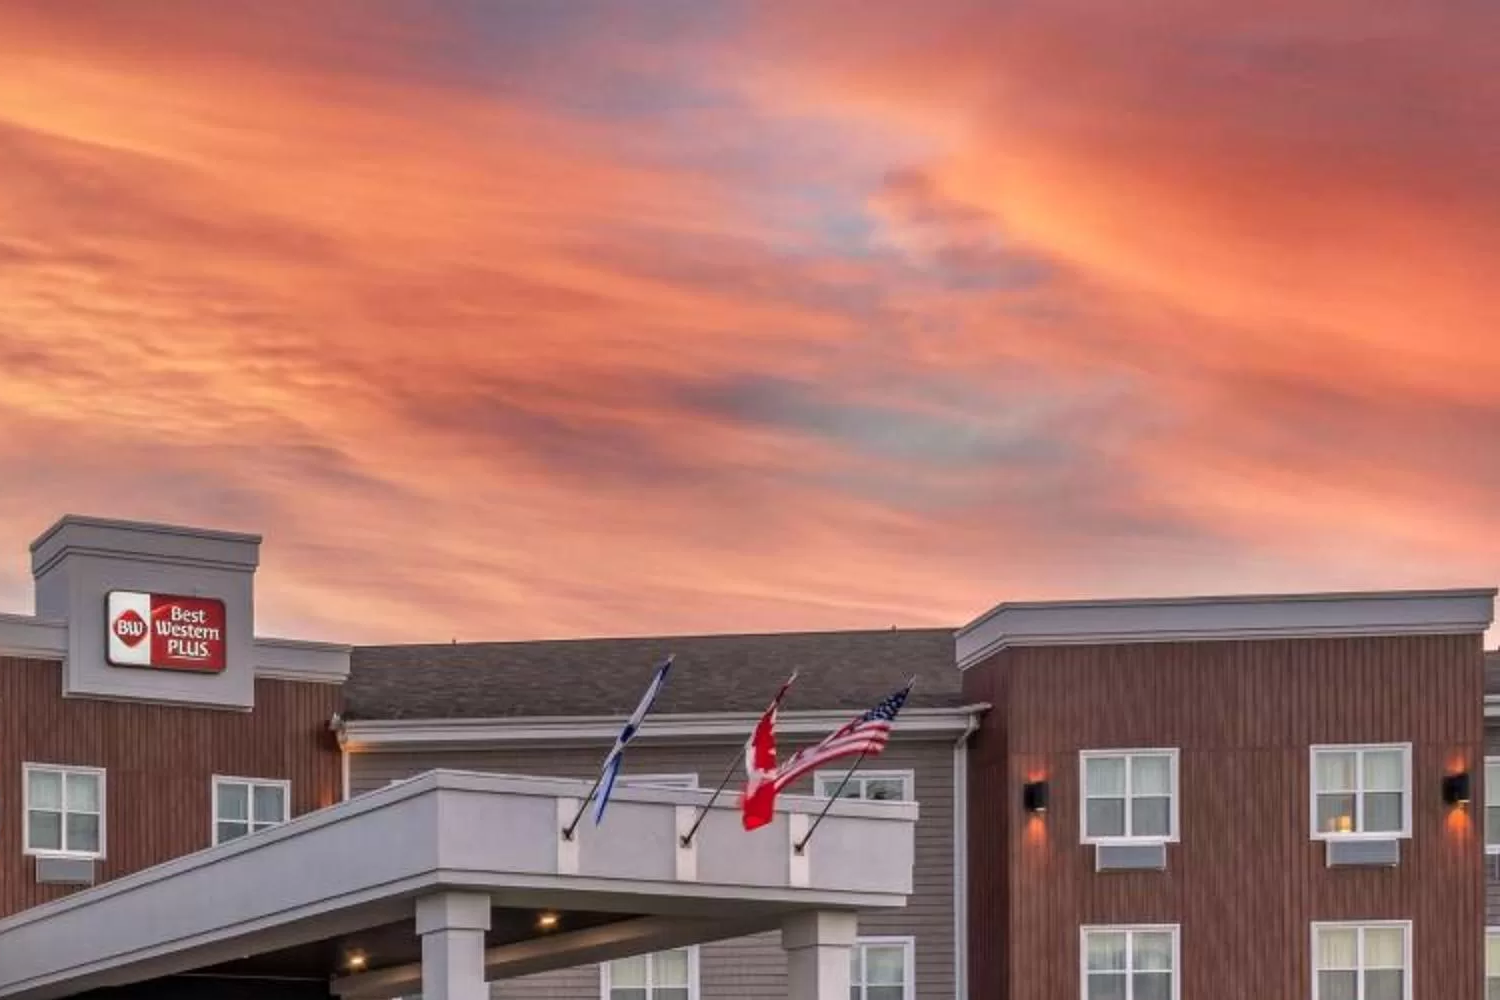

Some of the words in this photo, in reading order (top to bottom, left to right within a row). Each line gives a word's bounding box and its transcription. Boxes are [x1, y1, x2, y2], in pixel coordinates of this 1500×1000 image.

[171, 606, 206, 623] Best
[117, 620, 143, 636] BW
[155, 620, 220, 640] Western
[167, 640, 209, 657] PLUS
